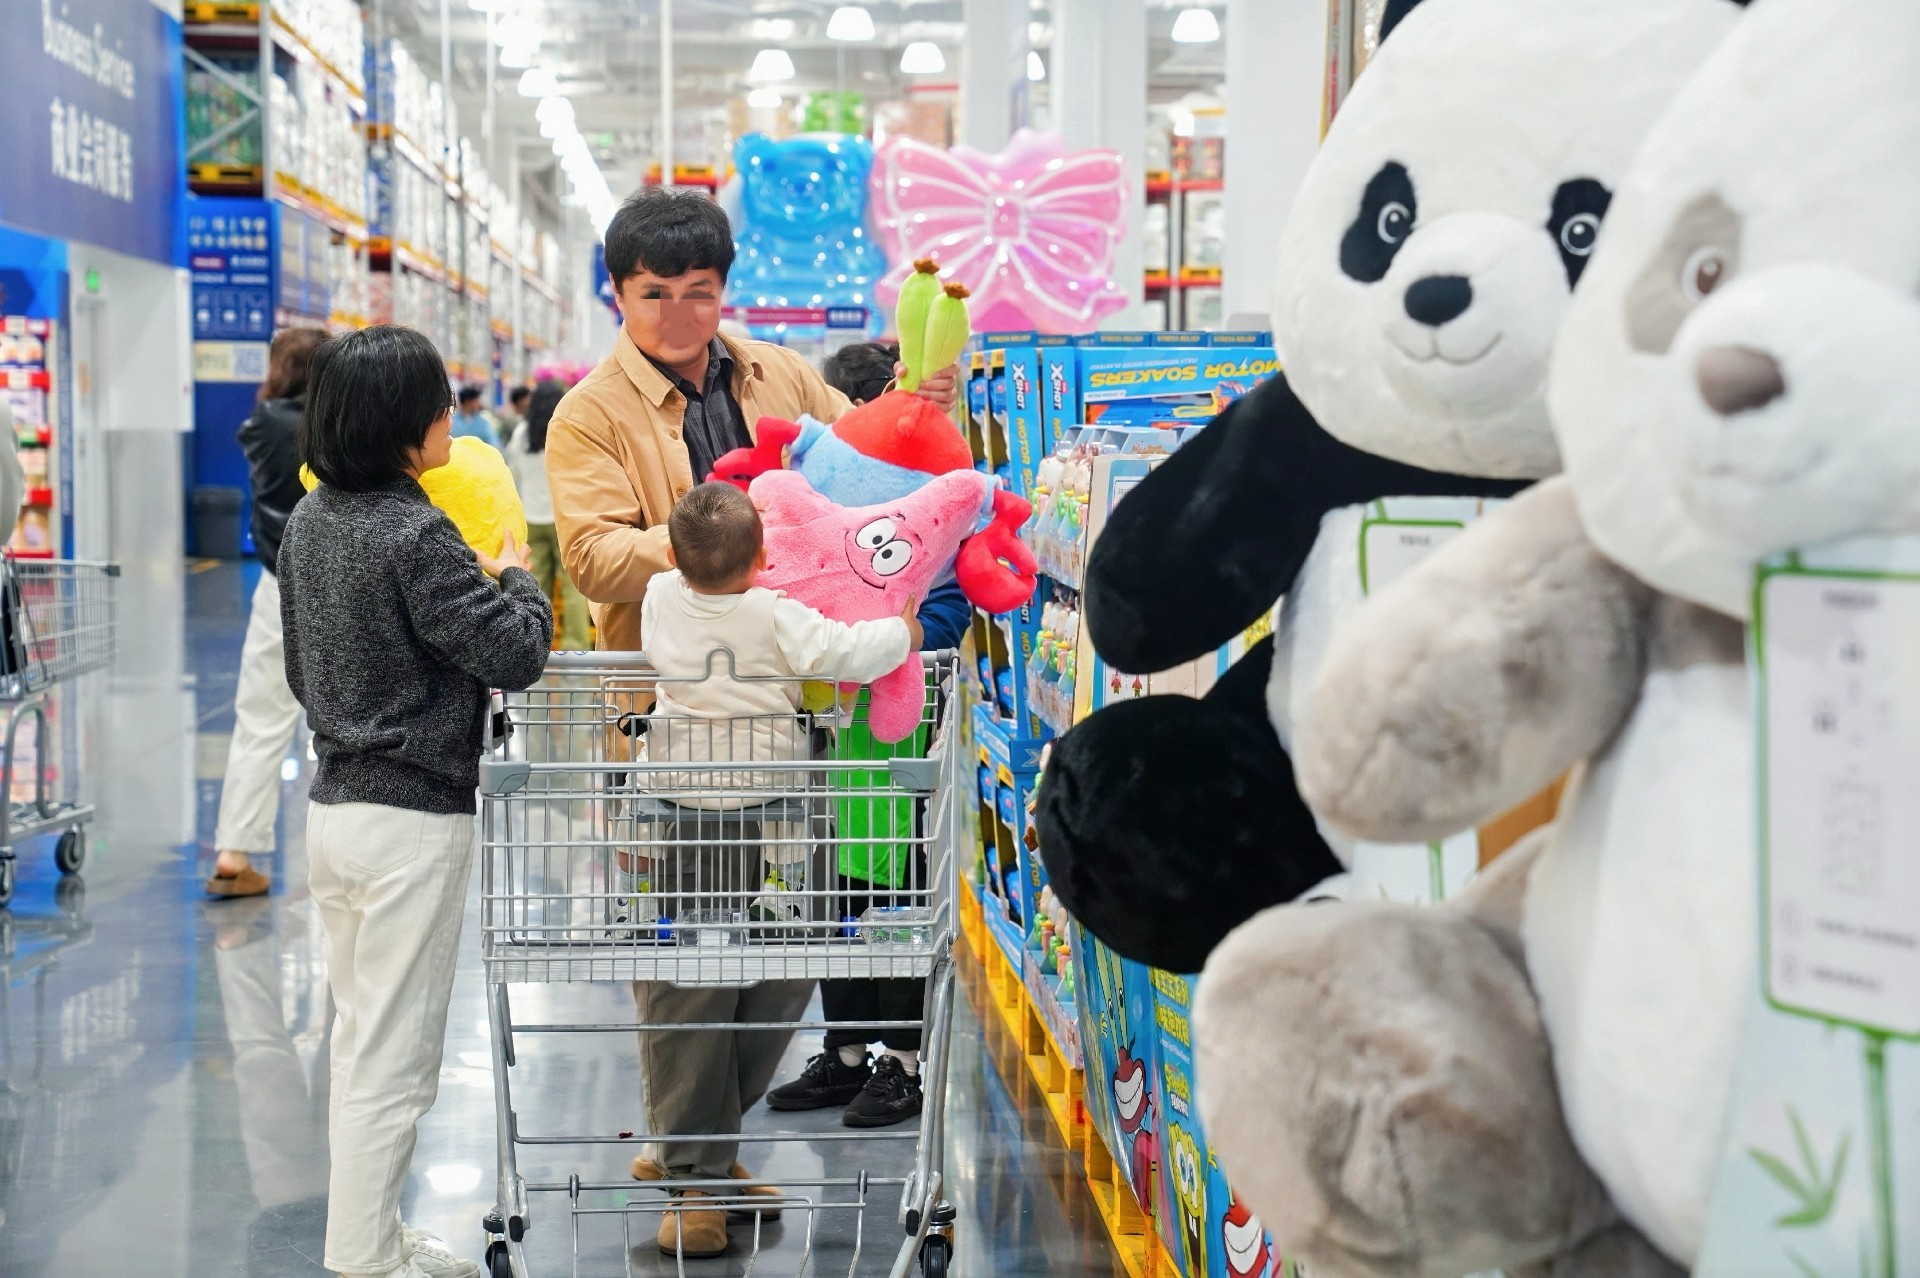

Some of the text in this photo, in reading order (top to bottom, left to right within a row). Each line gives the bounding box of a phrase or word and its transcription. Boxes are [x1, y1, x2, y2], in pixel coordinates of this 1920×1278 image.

[1090, 365, 1198, 388] SOAKERS
[1204, 359, 1281, 378] MOTOR
[1017, 417, 1031, 465] MOTOR
